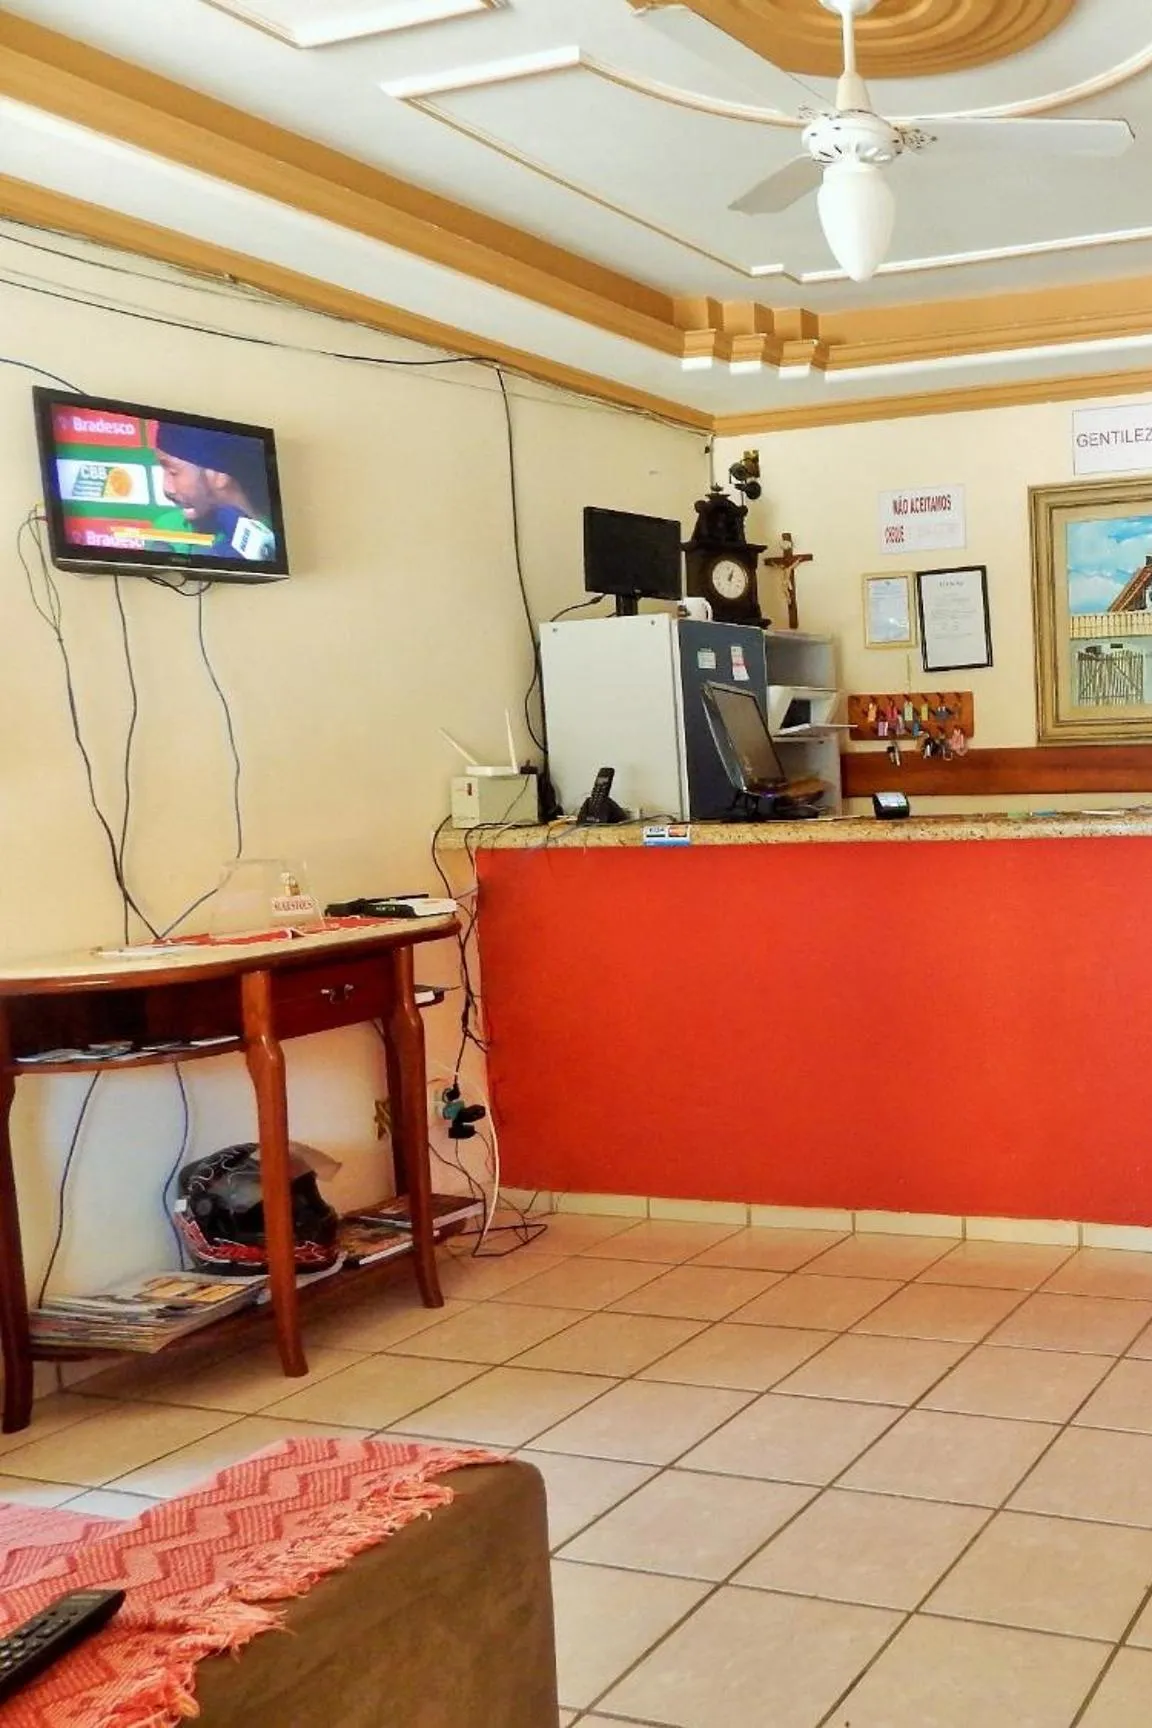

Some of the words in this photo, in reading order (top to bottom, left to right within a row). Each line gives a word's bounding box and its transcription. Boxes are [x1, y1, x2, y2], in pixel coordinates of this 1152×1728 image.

[72, 416, 136, 436] Bradesco
[892, 495, 909, 516] NÃO
[910, 493, 952, 514] ACEITAMOS
